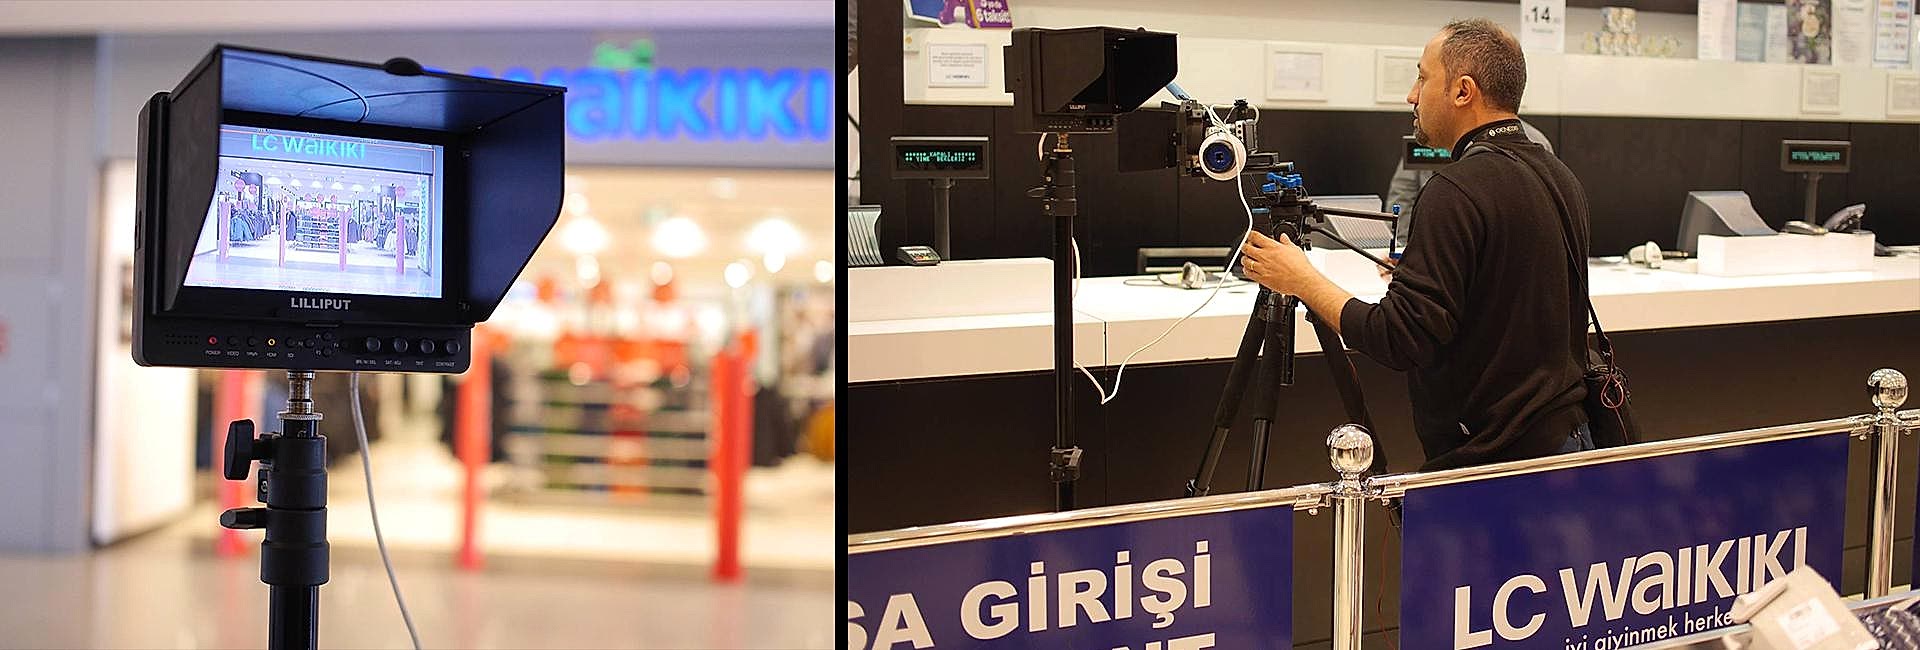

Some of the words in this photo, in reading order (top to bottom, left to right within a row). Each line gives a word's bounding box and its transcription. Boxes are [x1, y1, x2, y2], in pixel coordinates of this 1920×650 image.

[1531, 6, 1551, 23] 14
[251, 134, 278, 152] LC
[290, 296, 352, 311] LILLIPUT
[960, 540, 1212, 640] GİRİŞİ
[1454, 574, 1547, 650] LC
[1684, 606, 1732, 634] herke
